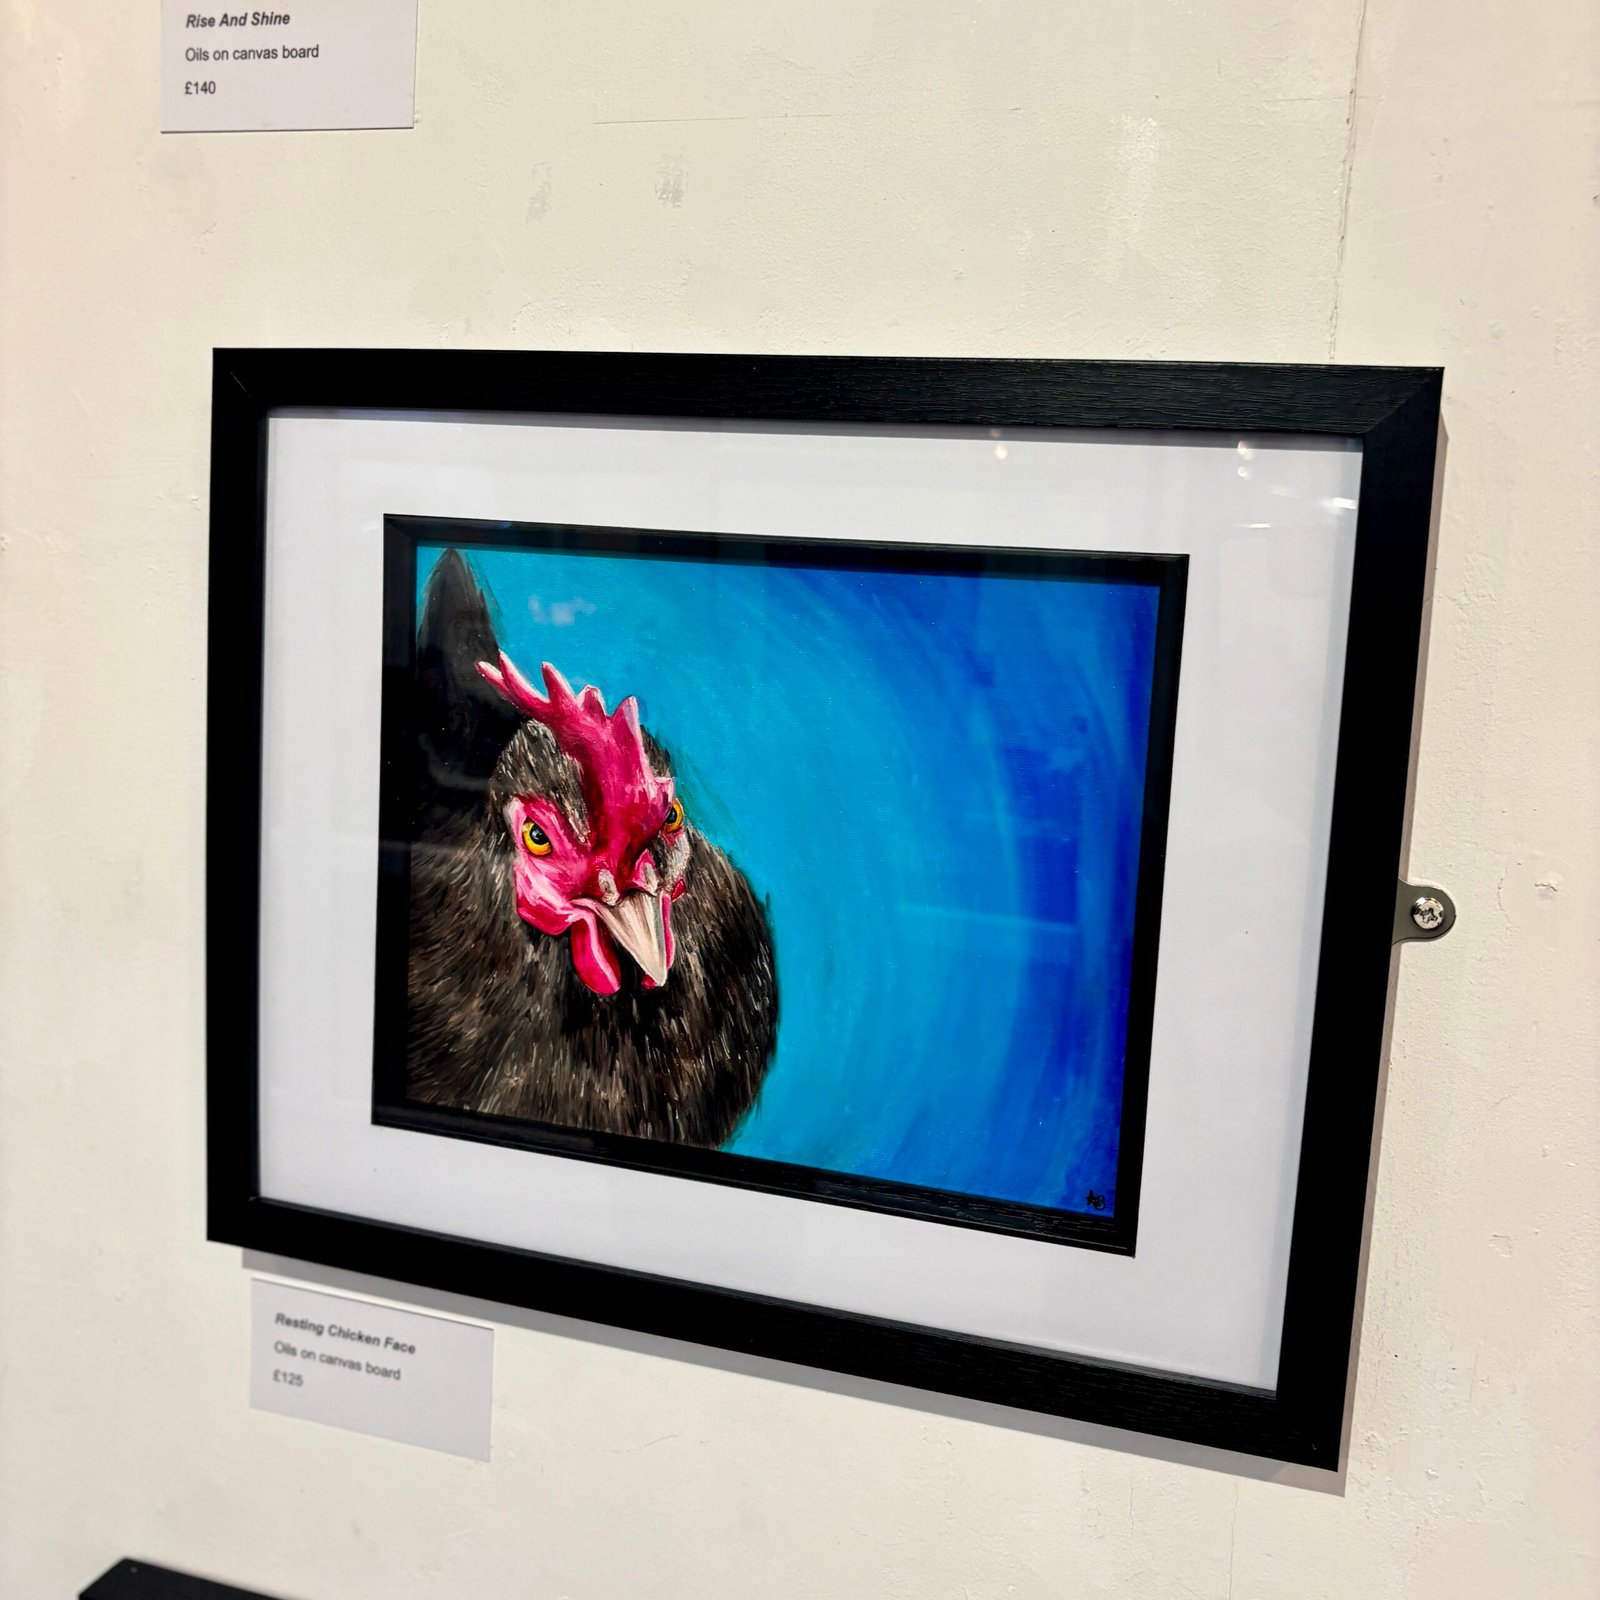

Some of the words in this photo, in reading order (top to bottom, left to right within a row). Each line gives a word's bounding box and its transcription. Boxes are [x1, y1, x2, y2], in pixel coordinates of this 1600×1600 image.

[185, 14, 216, 28] Rise
[219, 12, 248, 27] And
[251, 11, 291, 26] Shine
[185, 47, 210, 62] Oils
[213, 50, 229, 61] on
[232, 48, 278, 60] canvas
[282, 44, 319, 59] board
[185, 81, 216, 95] £140
[275, 1312, 325, 1336] Resting
[328, 1324, 380, 1347] Chicken
[384, 1337, 416, 1355] Face
[274, 1340, 298, 1357] Oils
[301, 1349, 316, 1361] on
[319, 1353, 362, 1372] canvas
[365, 1362, 401, 1381] board
[273, 1369, 304, 1387] £125
